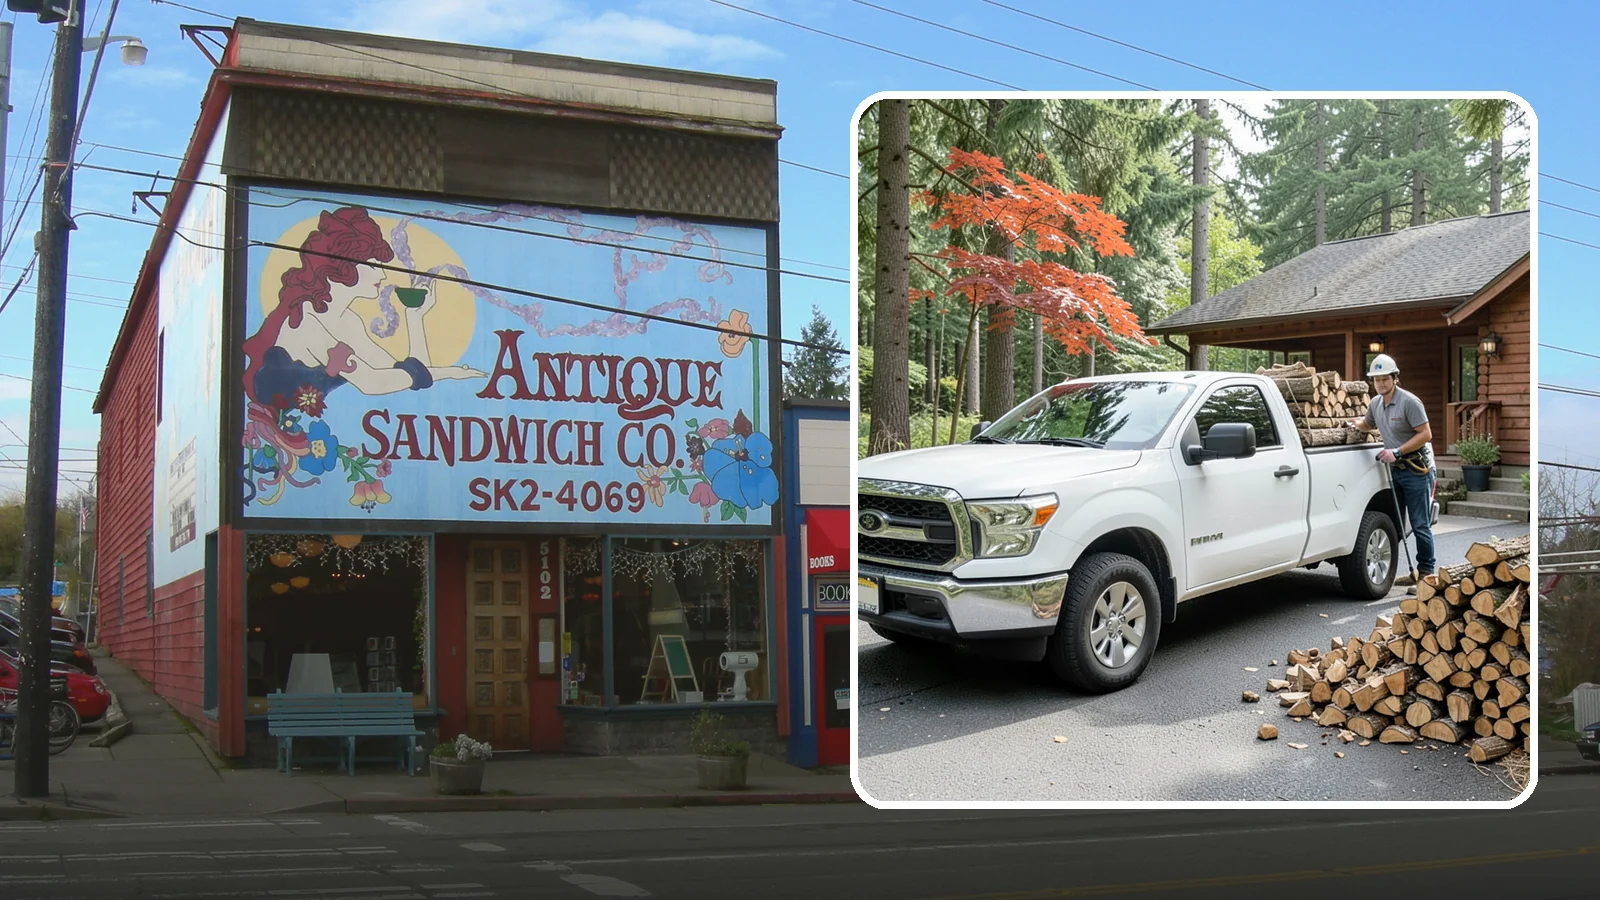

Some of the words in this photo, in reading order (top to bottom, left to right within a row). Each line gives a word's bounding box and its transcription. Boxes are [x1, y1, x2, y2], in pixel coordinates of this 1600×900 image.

[476, 329, 723, 421] ANTIQUE
[361, 409, 604, 467] SANDWICH
[617, 421, 685, 469] CO.
[468, 477, 645, 513] SK2-4069
[539, 541, 552, 600] 5102
[809, 555, 835, 569] BOOKS
